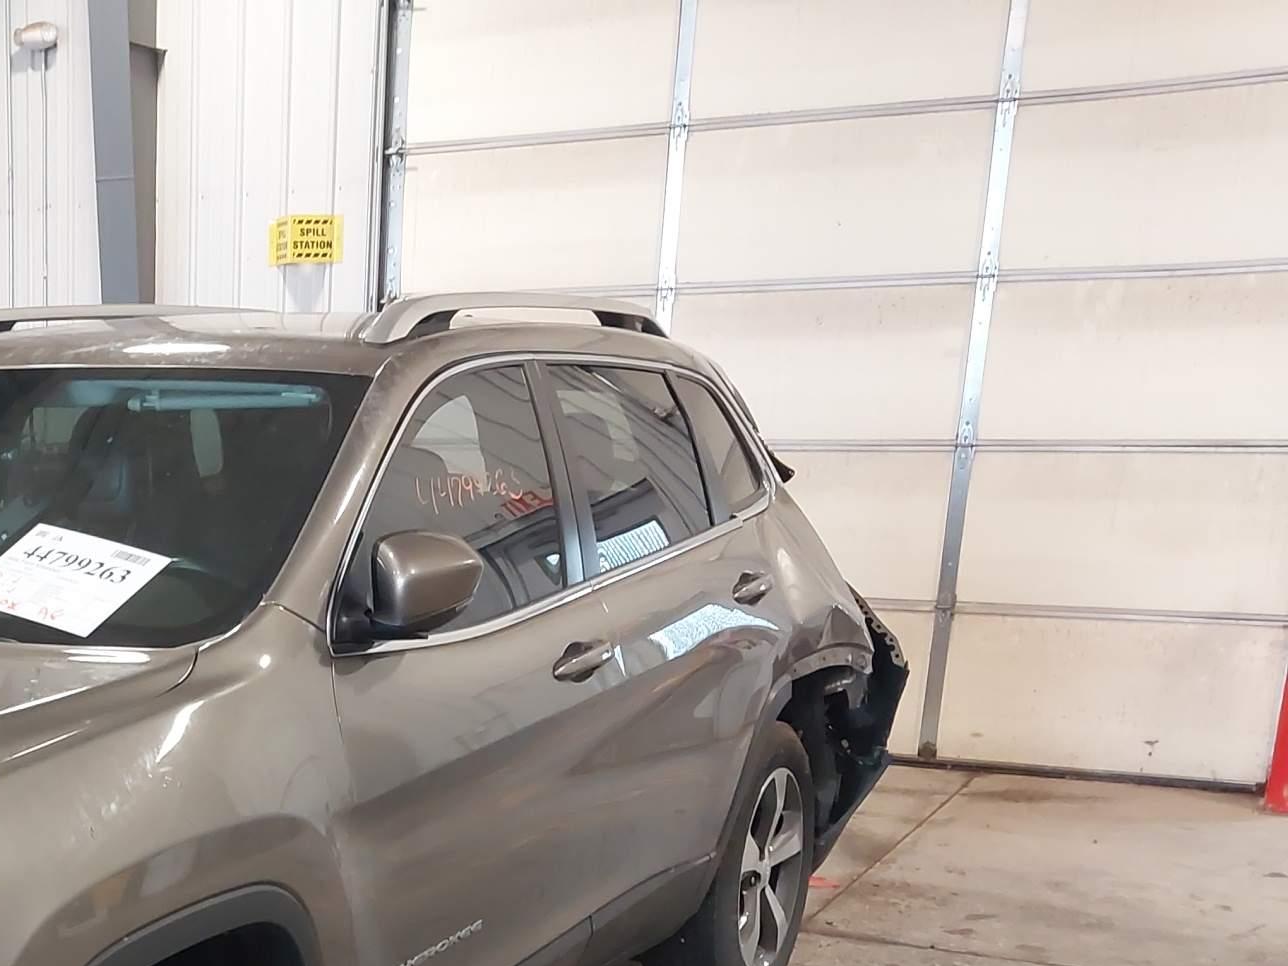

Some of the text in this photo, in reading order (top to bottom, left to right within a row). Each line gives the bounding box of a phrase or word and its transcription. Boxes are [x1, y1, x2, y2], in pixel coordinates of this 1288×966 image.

[299, 227, 327, 237] SPILL
[292, 240, 333, 250] STATION
[23, 545, 132, 584] 44799263
